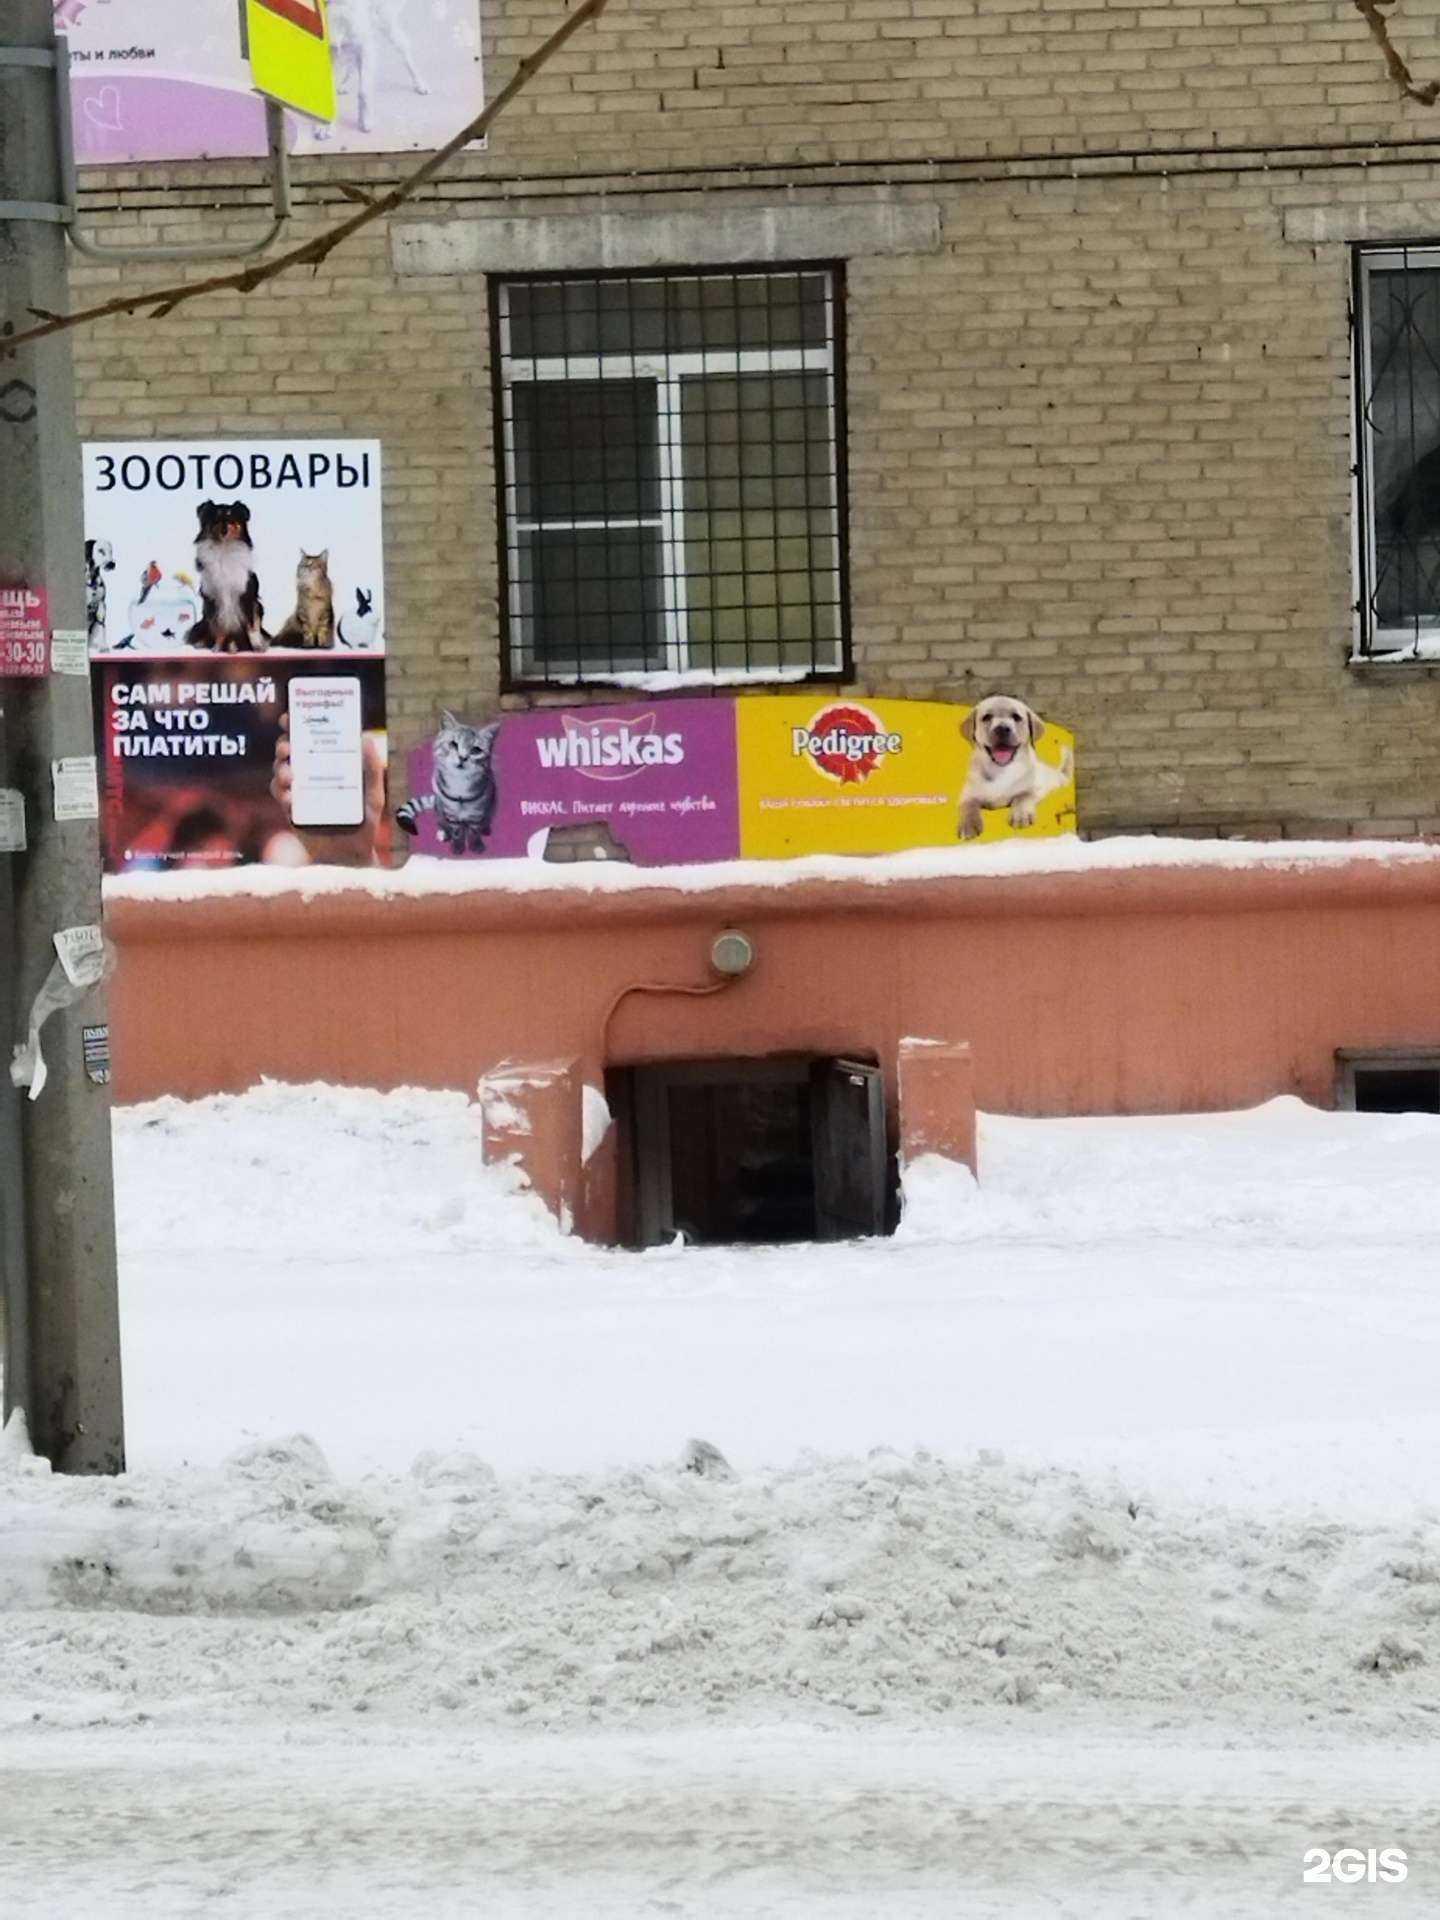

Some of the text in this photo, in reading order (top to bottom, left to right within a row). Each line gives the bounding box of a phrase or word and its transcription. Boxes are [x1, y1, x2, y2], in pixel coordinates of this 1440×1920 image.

[69, 46, 155, 61] ты и любви
[95, 453, 370, 491] ЗООТОВАРЫ
[0, 590, 40, 612] щь
[111, 677, 276, 705] САМ РЕШАЙ
[111, 709, 209, 731] ЗА ЧТО
[112, 734, 247, 757] ПЛАТИТЬ!
[536, 727, 685, 767] whiskas
[791, 727, 902, 761] Pedigree
